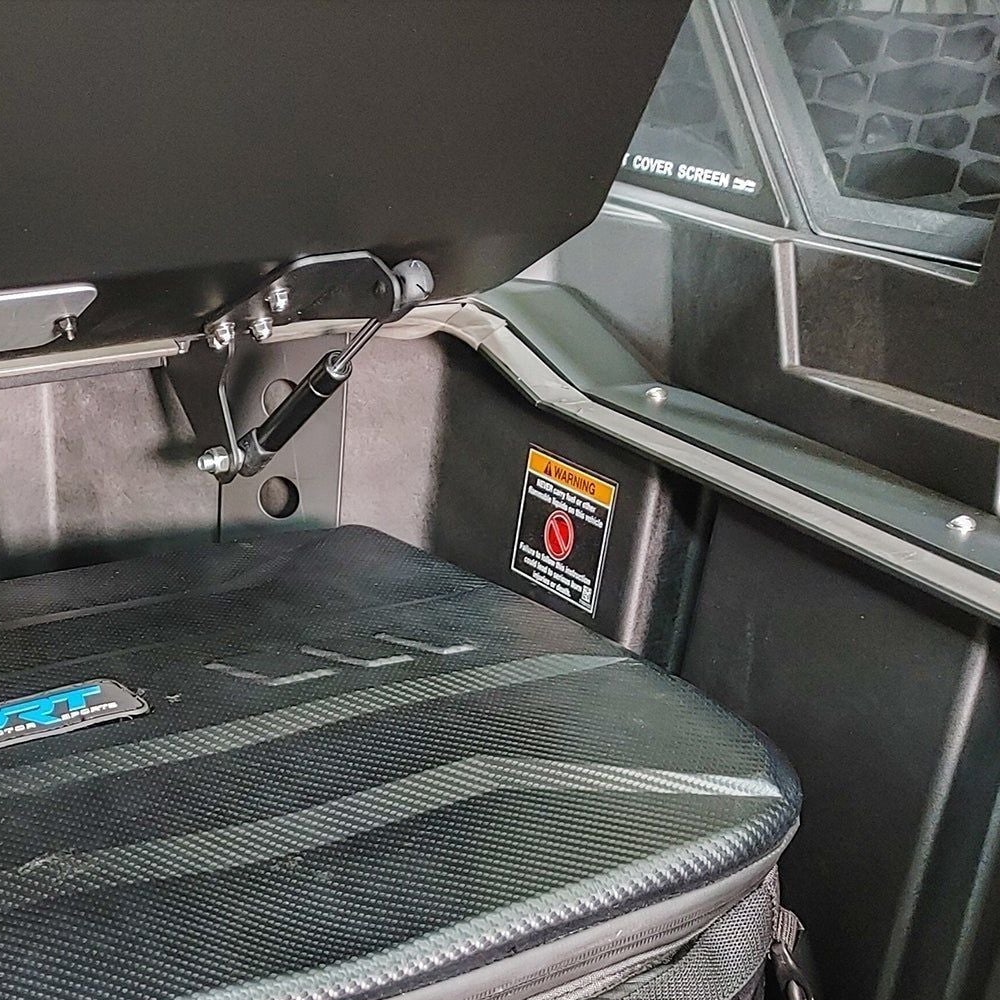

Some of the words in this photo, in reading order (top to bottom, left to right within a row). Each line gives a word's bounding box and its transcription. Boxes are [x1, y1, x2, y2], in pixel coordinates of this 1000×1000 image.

[632, 155, 674, 176] COVER
[677, 164, 730, 188] SCREEN
[554, 466, 596, 495] WARNING
[61, 702, 118, 721] SPORTS
